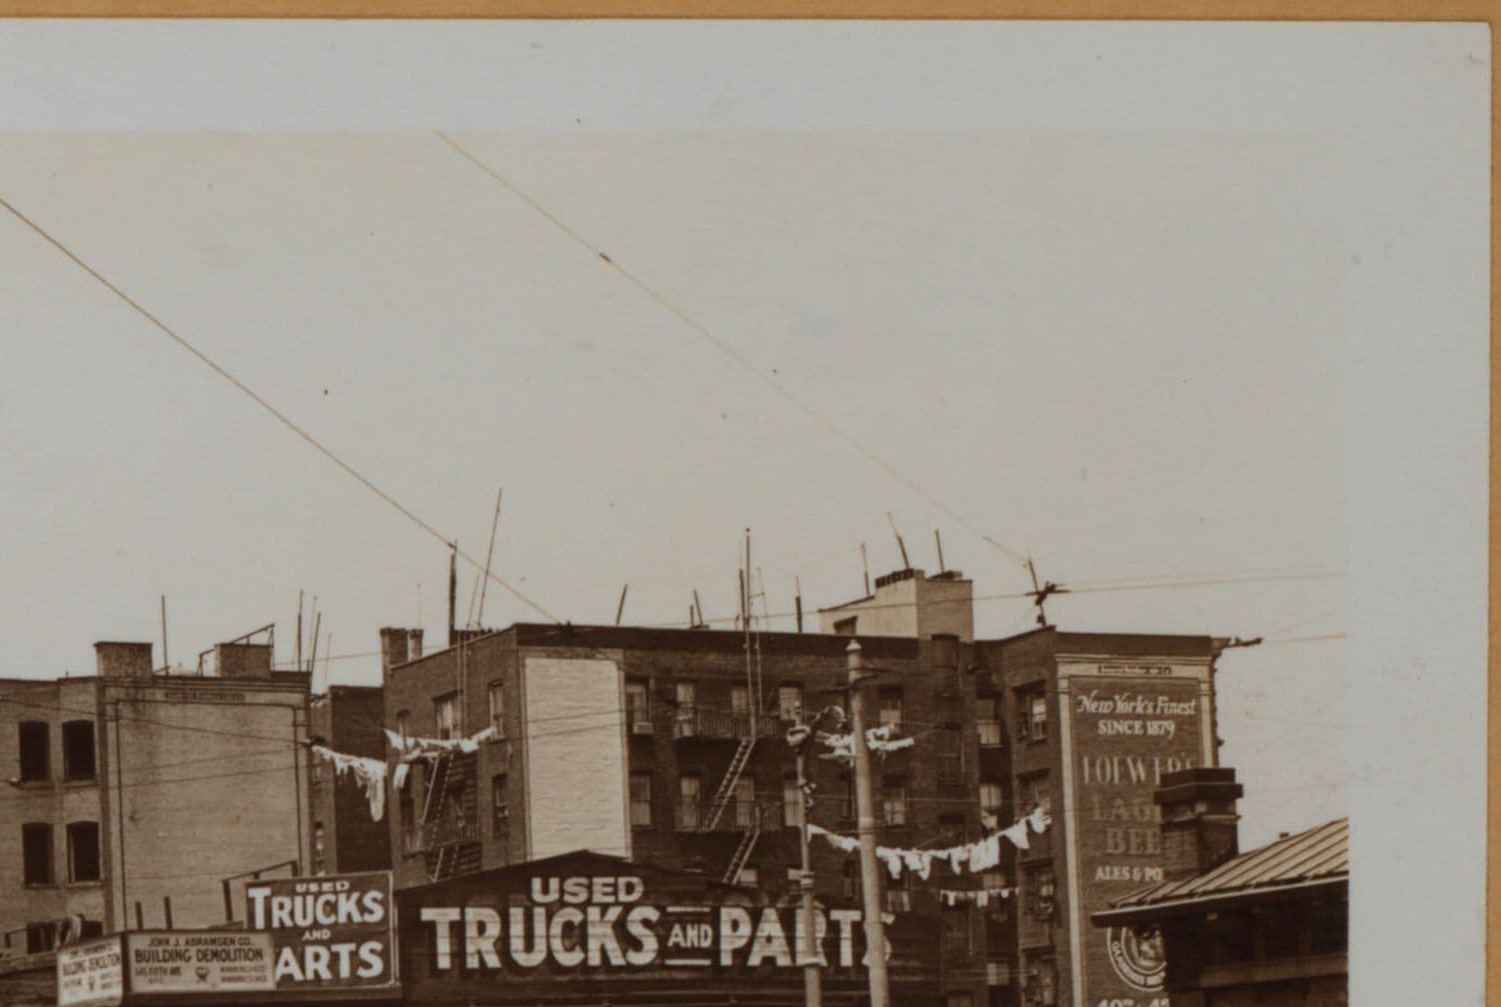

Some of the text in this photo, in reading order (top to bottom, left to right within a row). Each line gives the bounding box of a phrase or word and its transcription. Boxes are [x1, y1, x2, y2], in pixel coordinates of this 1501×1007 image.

[1076, 690, 1113, 713] New
[1156, 696, 1196, 715] Finest
[1098, 720, 1176, 739] SINCE 1879
[1095, 866, 1130, 881] ALES
[296, 881, 349, 893] USED
[531, 876, 644, 903] USED
[248, 887, 385, 930] TRUCKS
[302, 929, 331, 941] AND
[420, 906, 661, 969] TRUCKS
[668, 924, 713, 948] AND
[134, 948, 192, 963] BUILDING
[196, 946, 264, 962] DEMOLITION
[275, 940, 384, 982] ARTS
